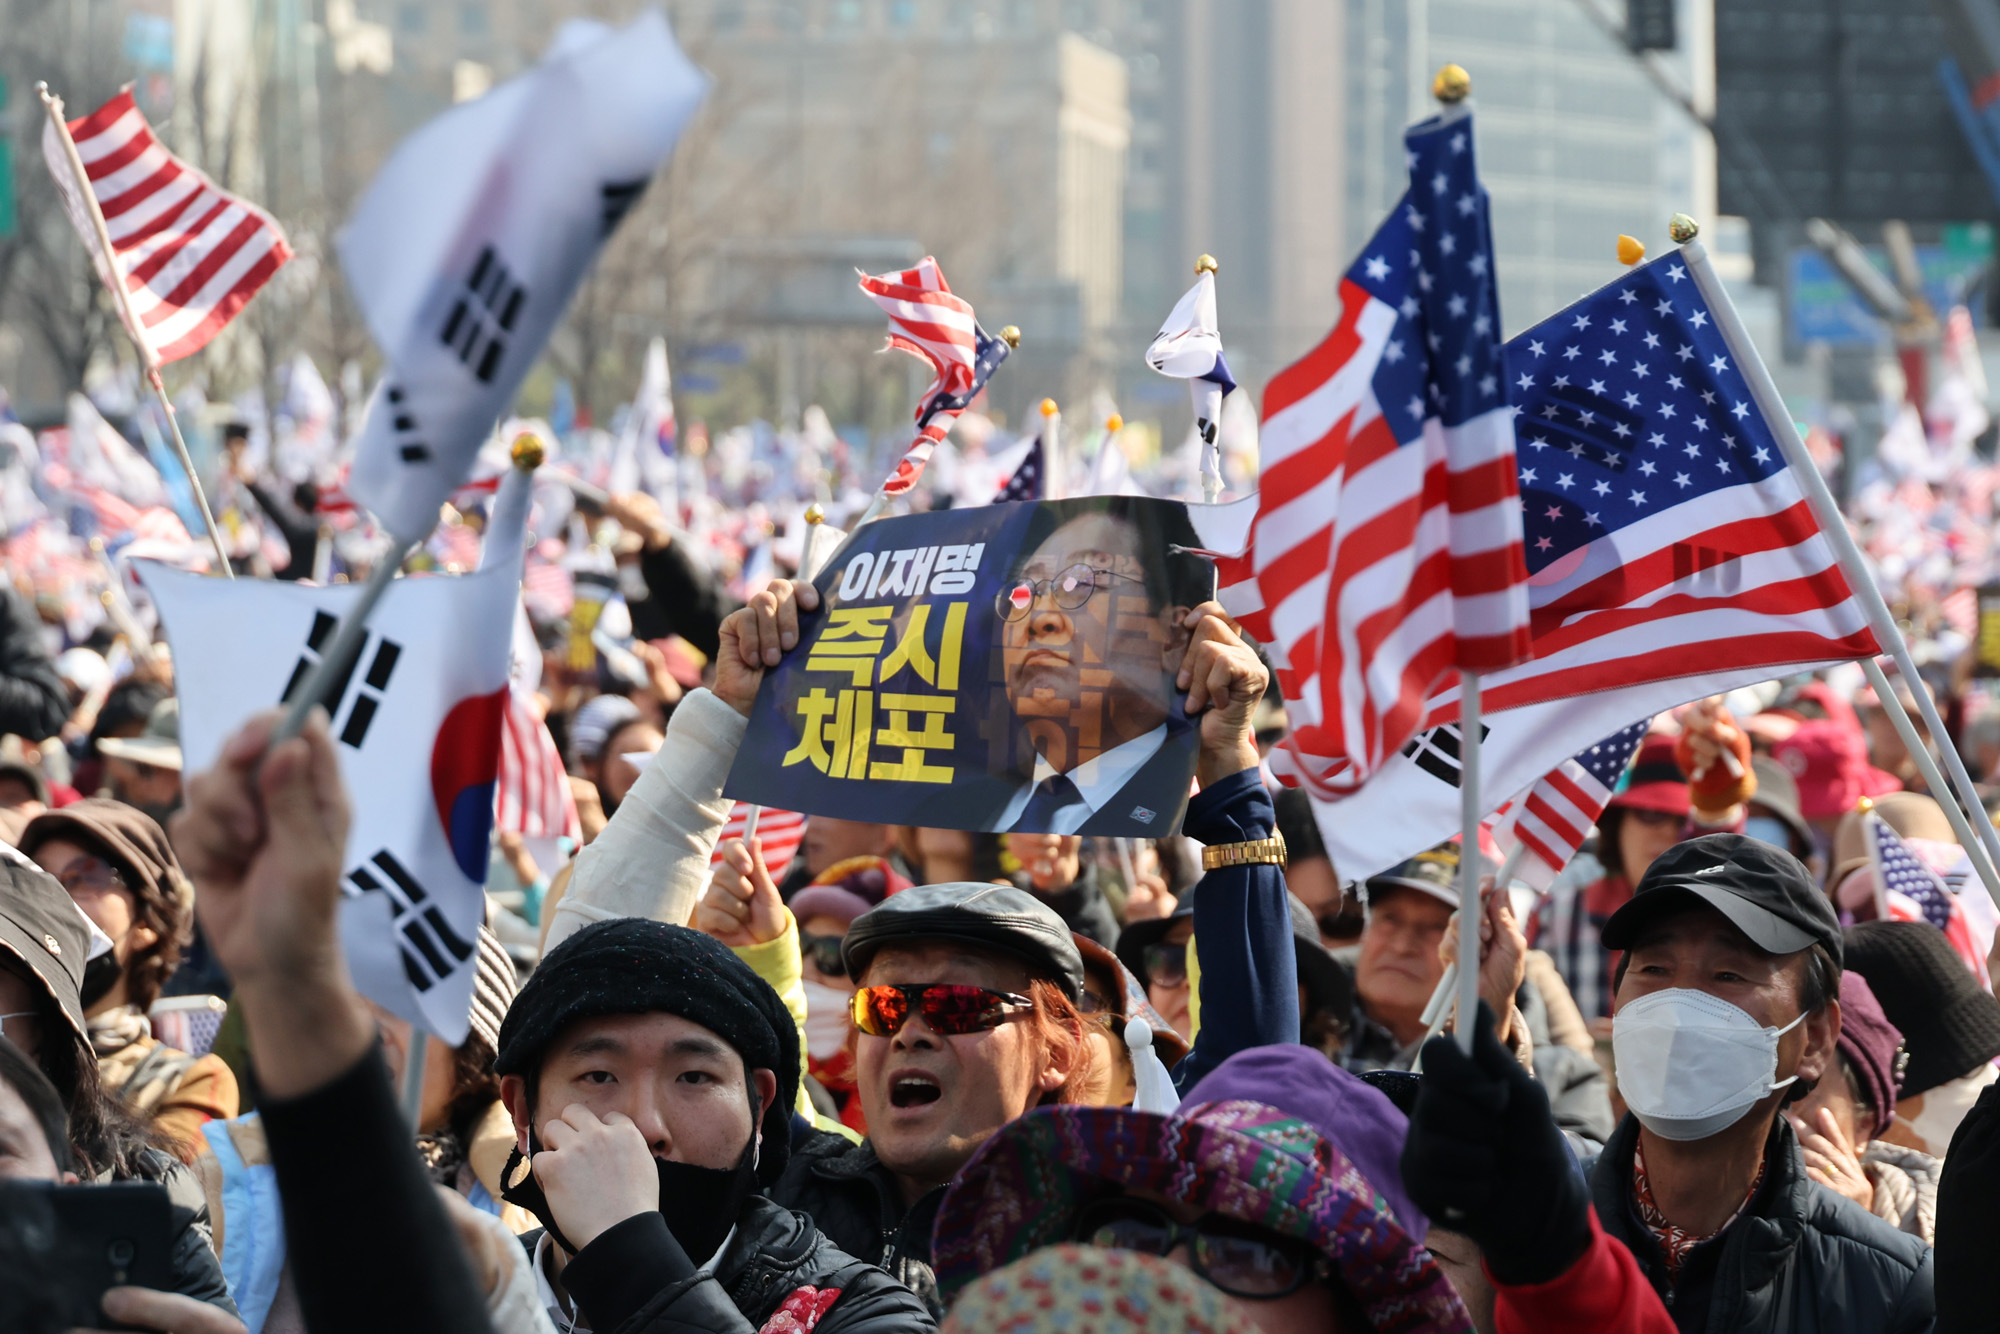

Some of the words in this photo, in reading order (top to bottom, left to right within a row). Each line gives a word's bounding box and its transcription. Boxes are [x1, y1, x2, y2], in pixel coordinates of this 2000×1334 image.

[838, 542, 986, 601] 이재명
[805, 602, 969, 690] 즉시
[781, 688, 956, 784] 체포
